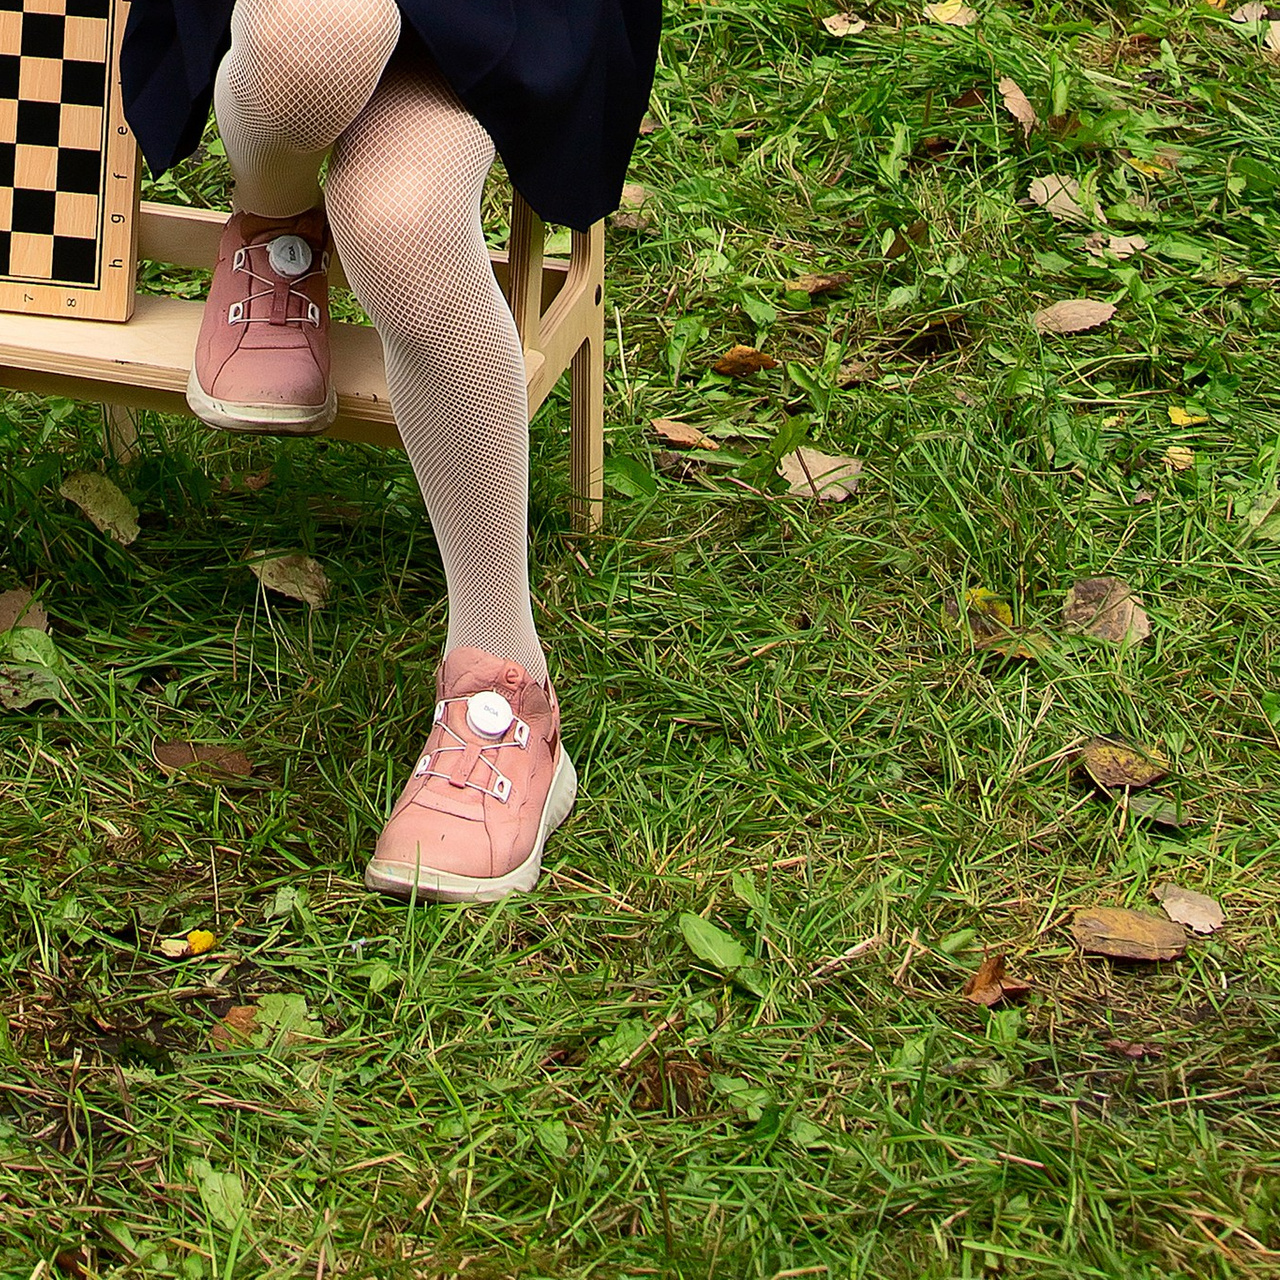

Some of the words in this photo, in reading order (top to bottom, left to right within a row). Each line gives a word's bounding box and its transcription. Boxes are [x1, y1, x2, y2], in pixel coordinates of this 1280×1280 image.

[117, 125, 128, 135] e
[113, 172, 128, 180] f
[110, 213, 125, 224] g
[108, 258, 123, 269] h
[23, 293, 34, 303] 7
[66, 297, 77, 308] 8
